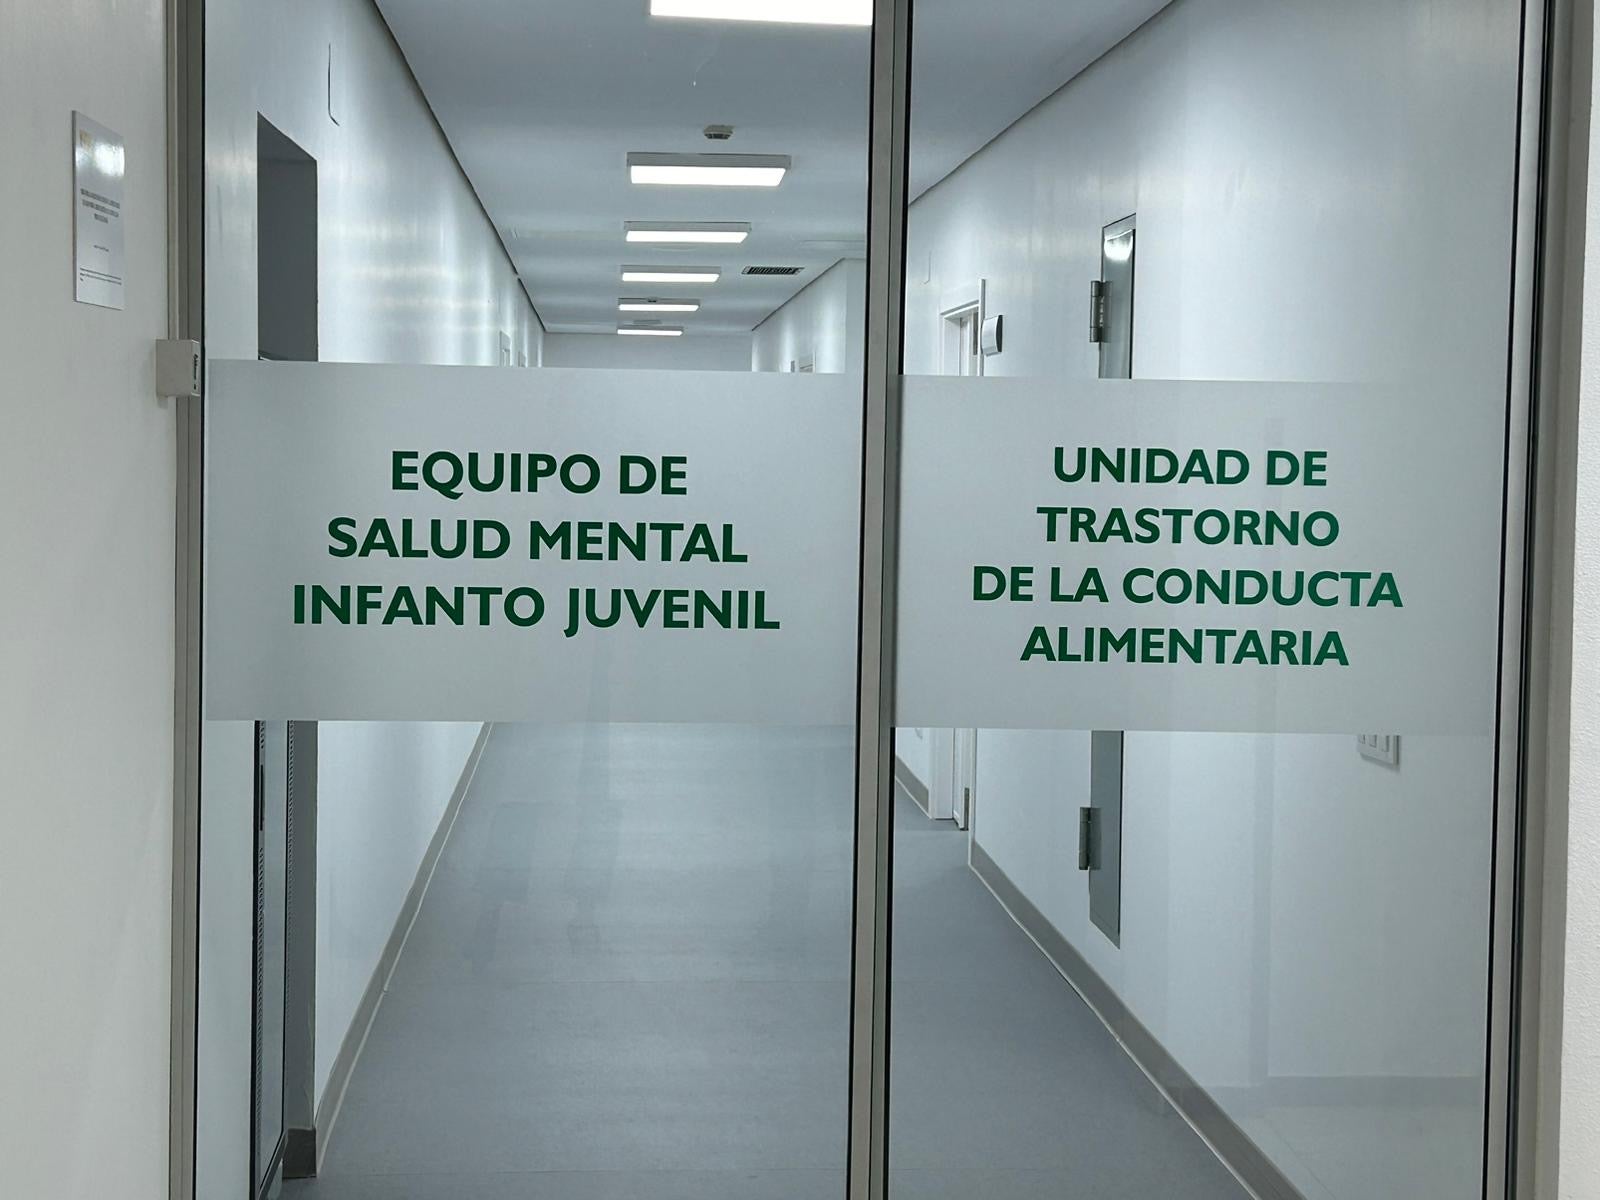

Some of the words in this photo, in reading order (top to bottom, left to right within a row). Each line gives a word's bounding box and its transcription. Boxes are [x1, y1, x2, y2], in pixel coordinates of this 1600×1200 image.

[392, 451, 600, 499] EQUIPO
[619, 455, 687, 495] DE
[1055, 447, 1250, 485] UNIDAD
[1267, 450, 1327, 487] DE
[328, 517, 510, 559] SALUD
[530, 521, 748, 563] MENTAL
[1037, 507, 1340, 547] TRASTORNO
[974, 566, 1033, 602] DE
[1051, 567, 1109, 603] LA
[1123, 568, 1403, 608] CONDUCTA
[294, 585, 545, 627] INFANTO
[564, 588, 780, 638] JUVENIL
[1021, 626, 1349, 667] ALIMENTARIA
